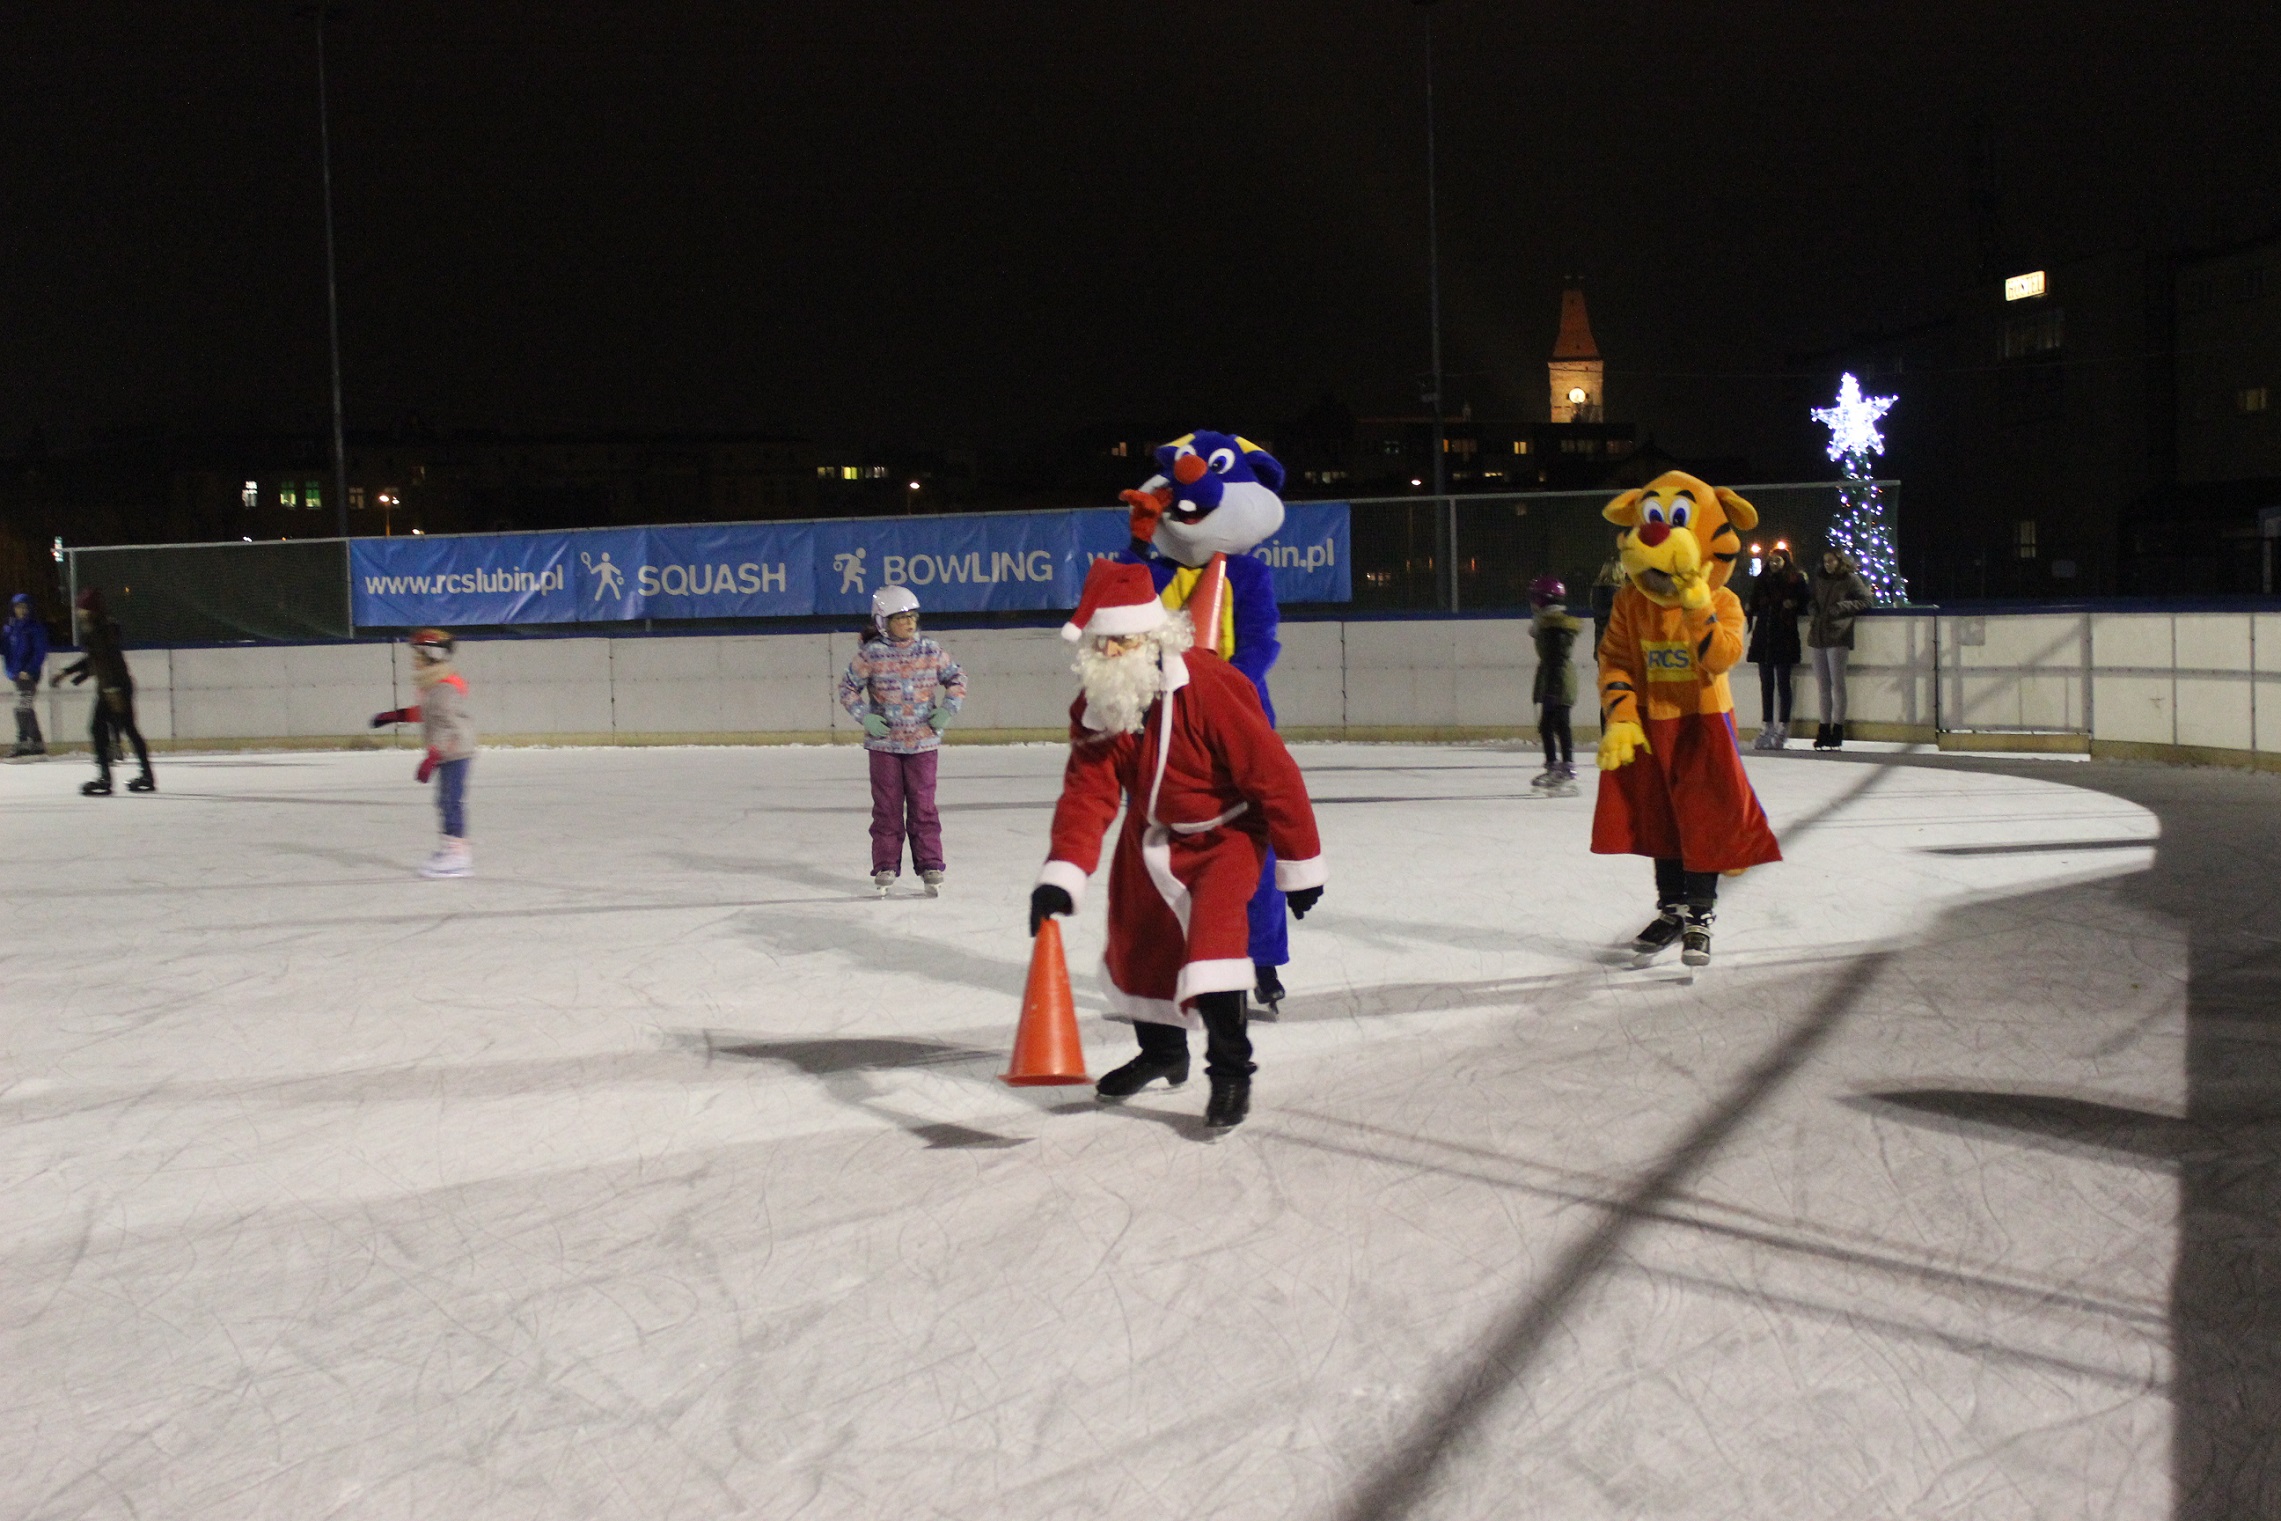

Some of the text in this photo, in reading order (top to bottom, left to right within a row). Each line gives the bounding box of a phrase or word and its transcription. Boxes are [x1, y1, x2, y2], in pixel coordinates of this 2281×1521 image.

[366, 567, 563, 595] www.rcslubin.pl
[638, 563, 786, 597] SQUASH
[883, 551, 1053, 586] BOWLING
[1648, 648, 1690, 668] RCS
